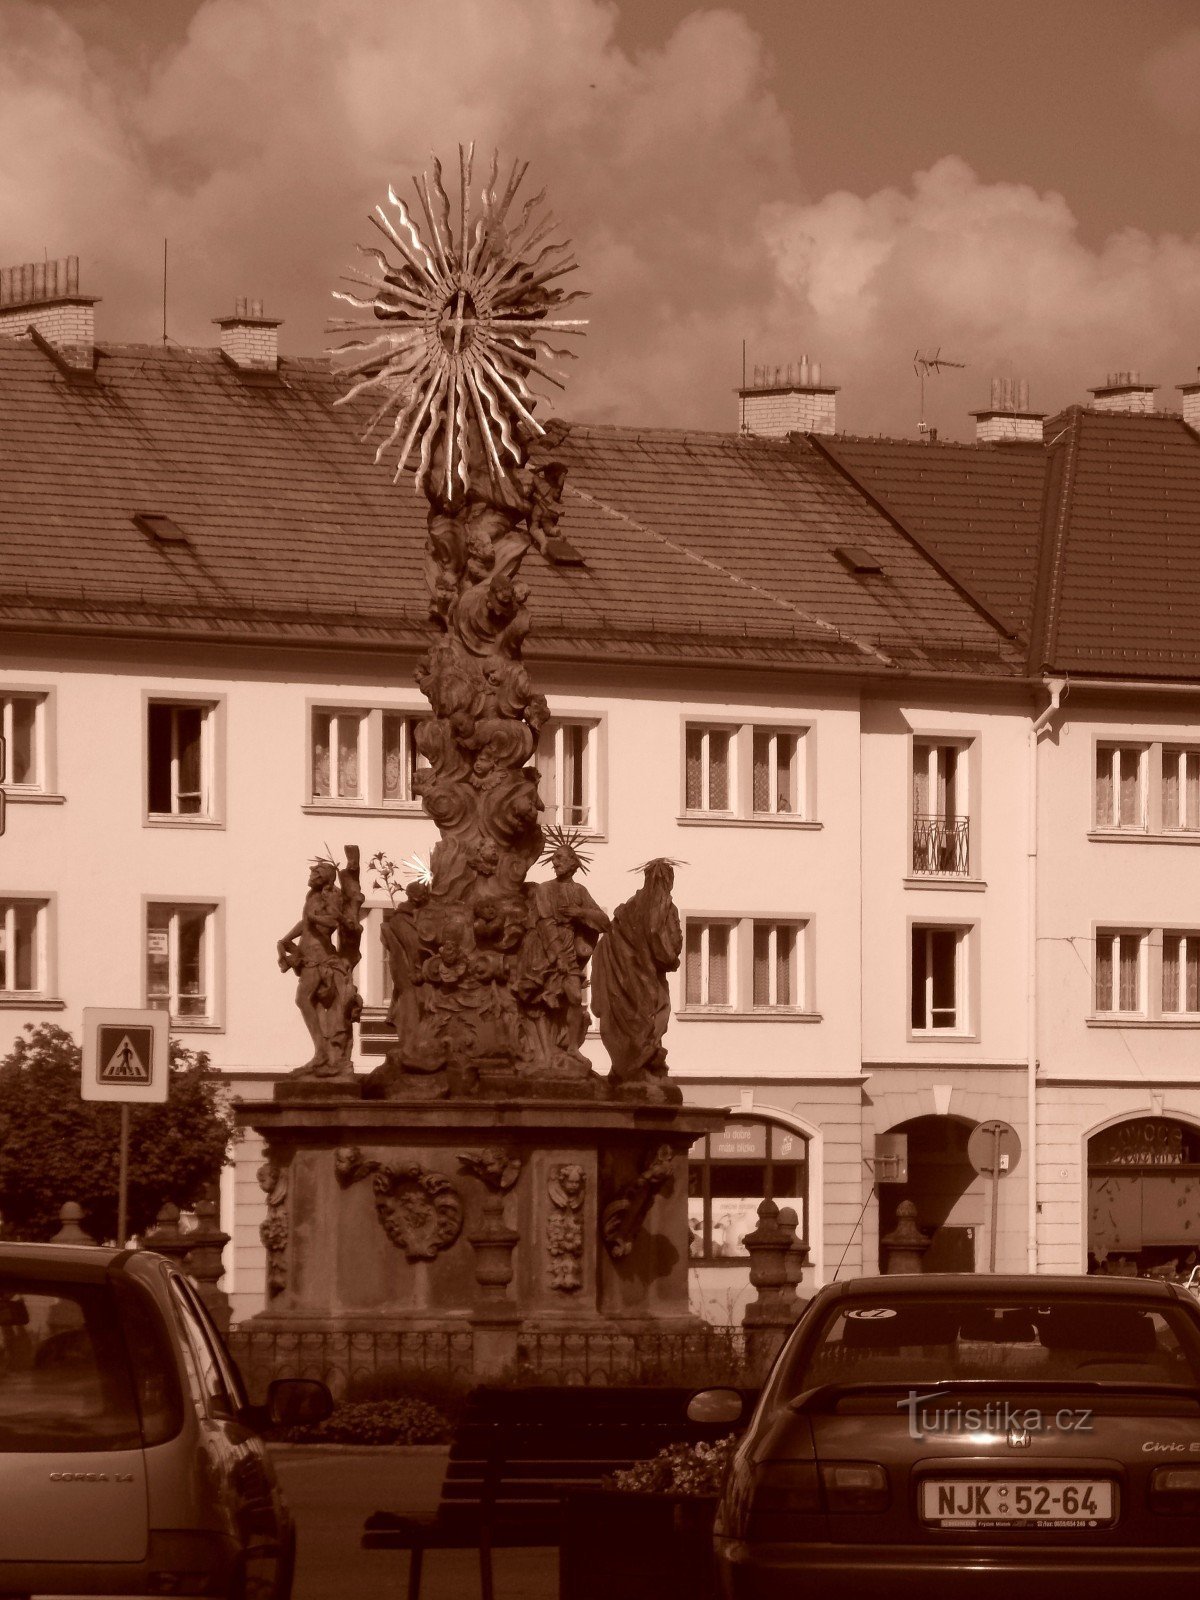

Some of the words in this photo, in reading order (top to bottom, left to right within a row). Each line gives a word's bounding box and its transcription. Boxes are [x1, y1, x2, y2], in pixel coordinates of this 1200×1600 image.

[855, 1309, 888, 1318] CZ
[1141, 1441, 1186, 1452] Civic
[49, 1472, 108, 1482] CORSA
[938, 1486, 992, 1515] NJK
[1015, 1486, 1097, 1515] 52-64
